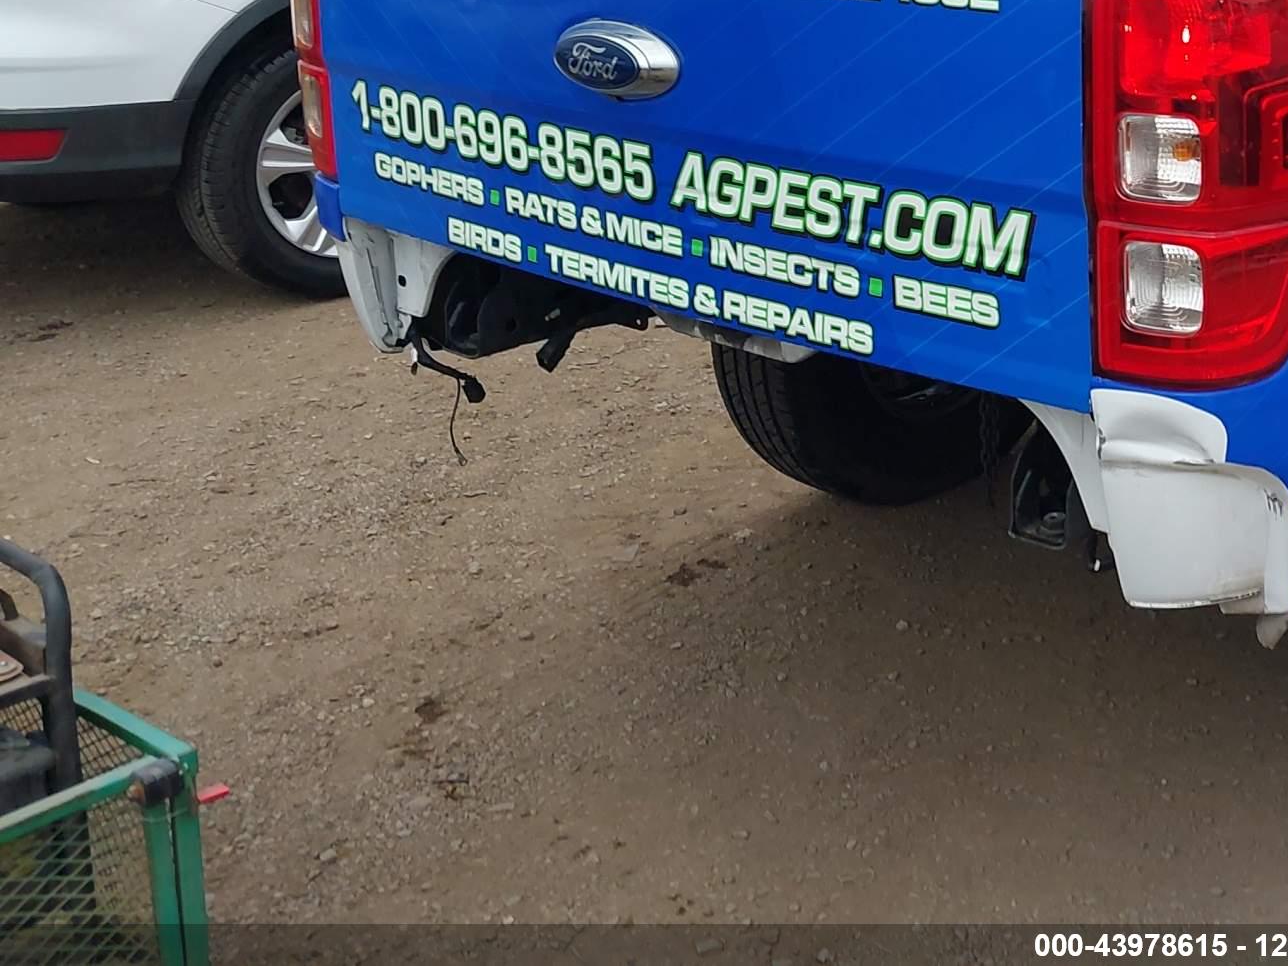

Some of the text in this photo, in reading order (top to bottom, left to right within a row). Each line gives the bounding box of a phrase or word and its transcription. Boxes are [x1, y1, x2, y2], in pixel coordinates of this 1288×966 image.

[567, 42, 618, 81] Ford
[351, 79, 1033, 278] 1-800-696-8565 AGPEST.COM
[374, 151, 1000, 328] GOPHERS RATS & MICE INSECTS BEES
[447, 216, 874, 356] BIRDS TERMITES & REPAIRS
